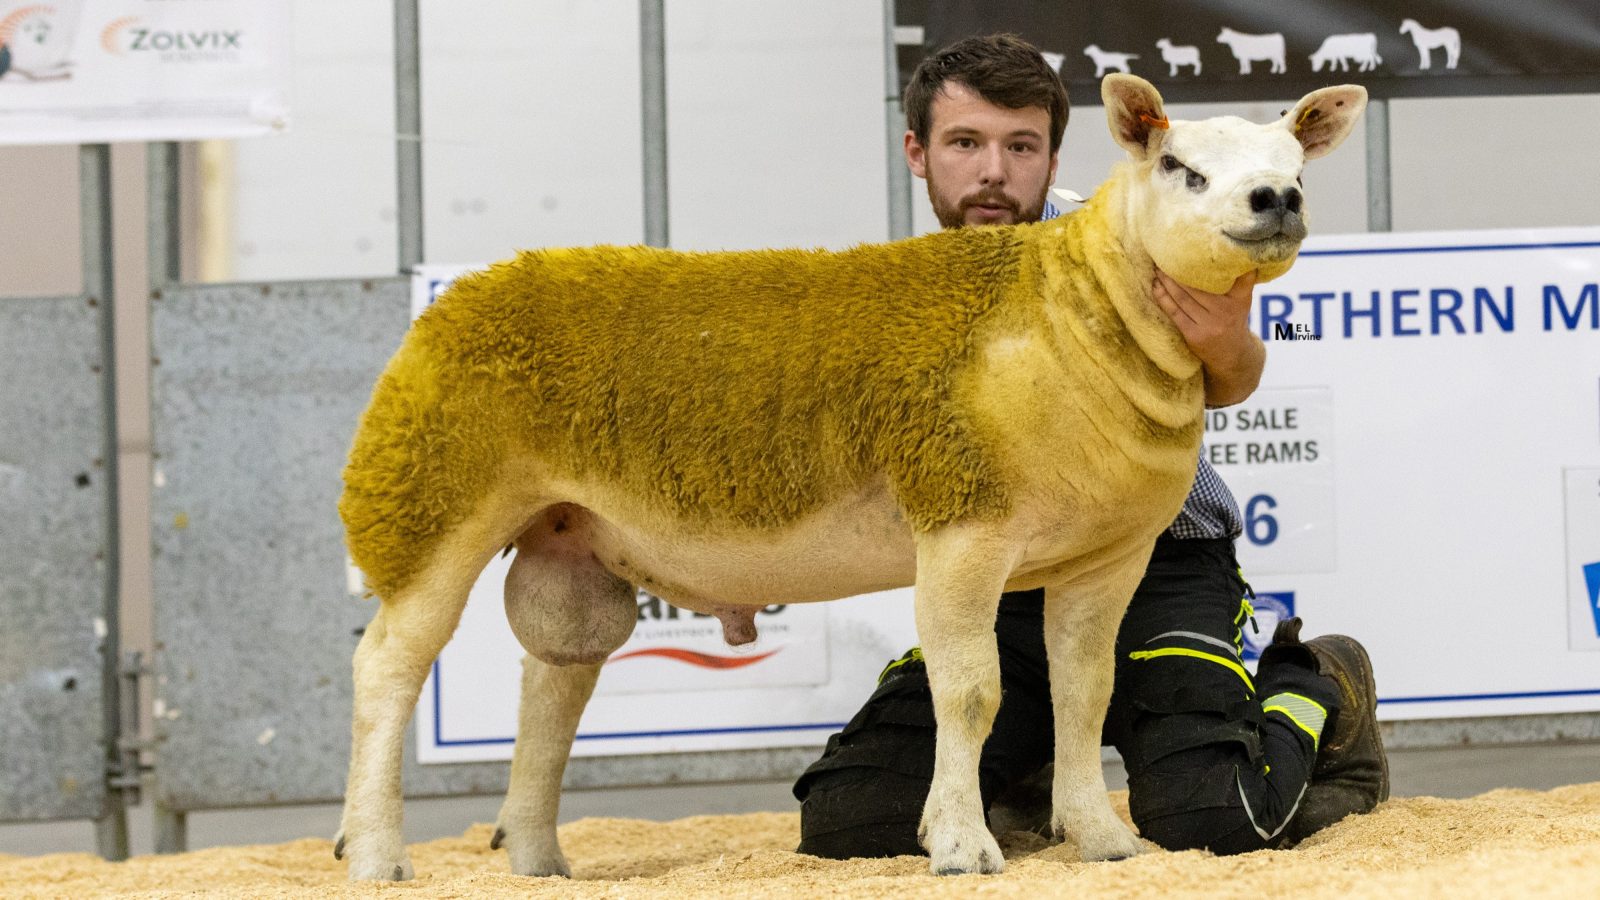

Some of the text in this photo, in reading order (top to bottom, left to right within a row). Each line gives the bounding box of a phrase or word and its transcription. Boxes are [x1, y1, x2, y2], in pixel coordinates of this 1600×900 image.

[129, 28, 243, 51] ZOLVIX
[1248, 284, 1515, 342] RTHERN
[1236, 408, 1298, 432] SALE
[1209, 440, 1319, 465] EE RAMS
